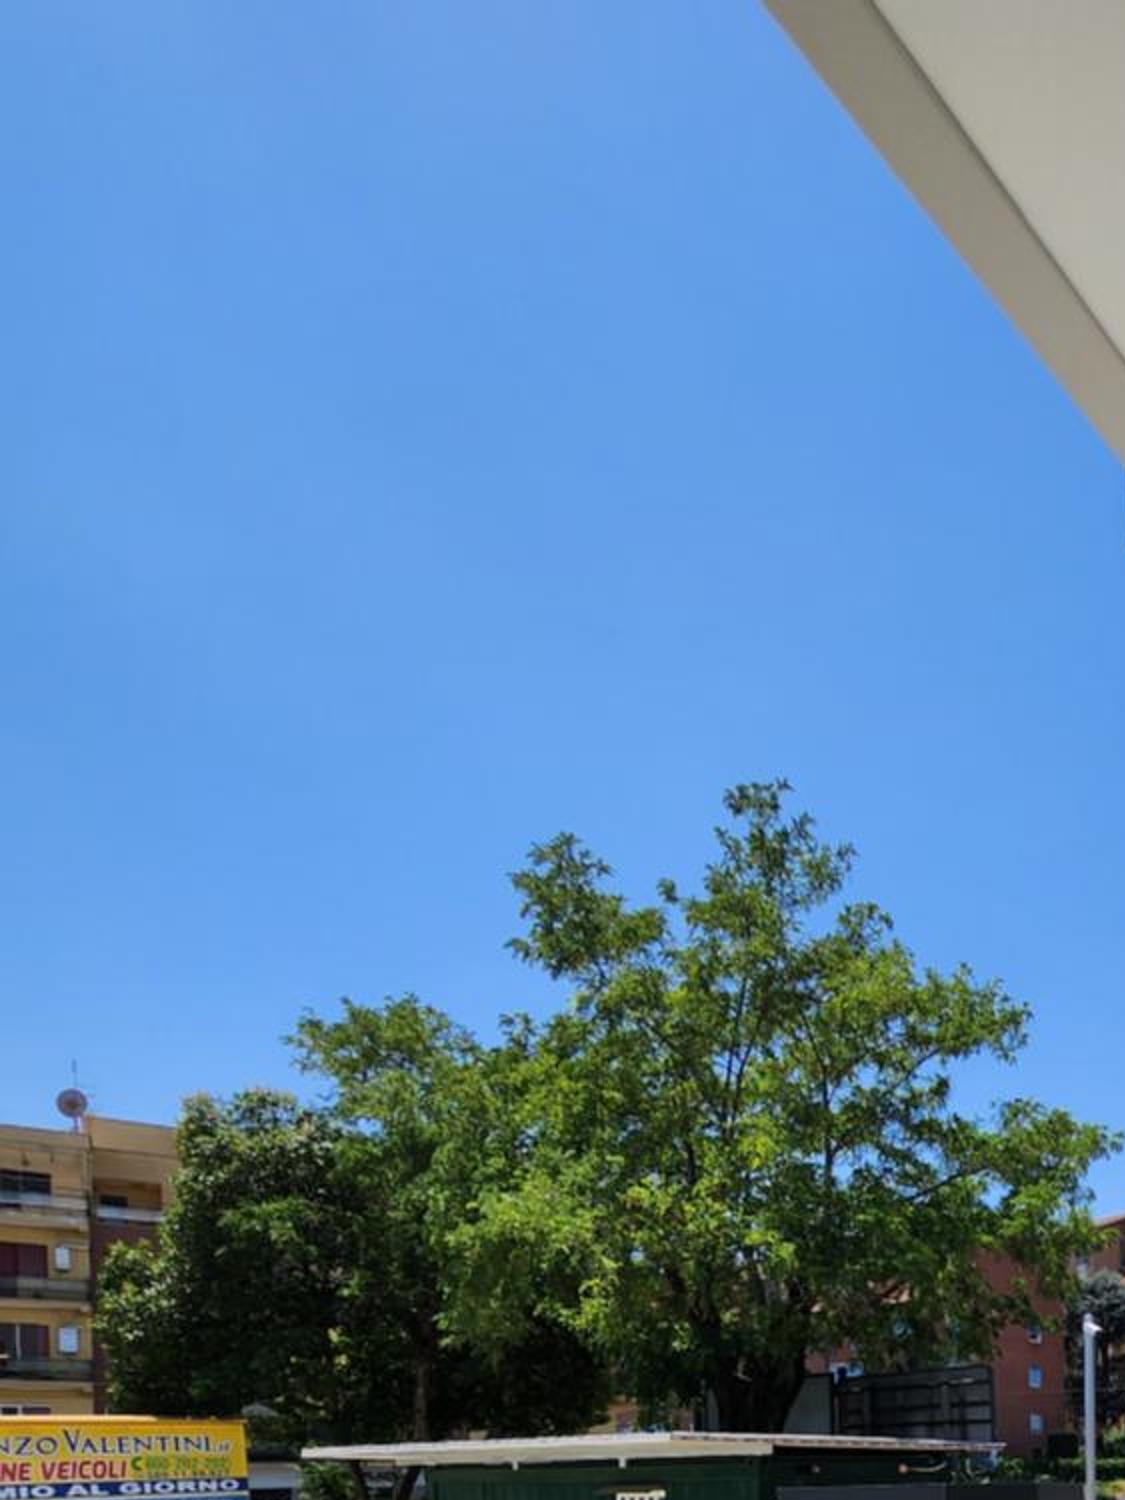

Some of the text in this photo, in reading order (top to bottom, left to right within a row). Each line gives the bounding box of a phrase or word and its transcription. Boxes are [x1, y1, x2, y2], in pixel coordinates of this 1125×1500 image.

[41, 1459, 128, 1480] VEICOLI
[65, 1483, 109, 1496] AL
[119, 1478, 240, 1494] GIORNO
